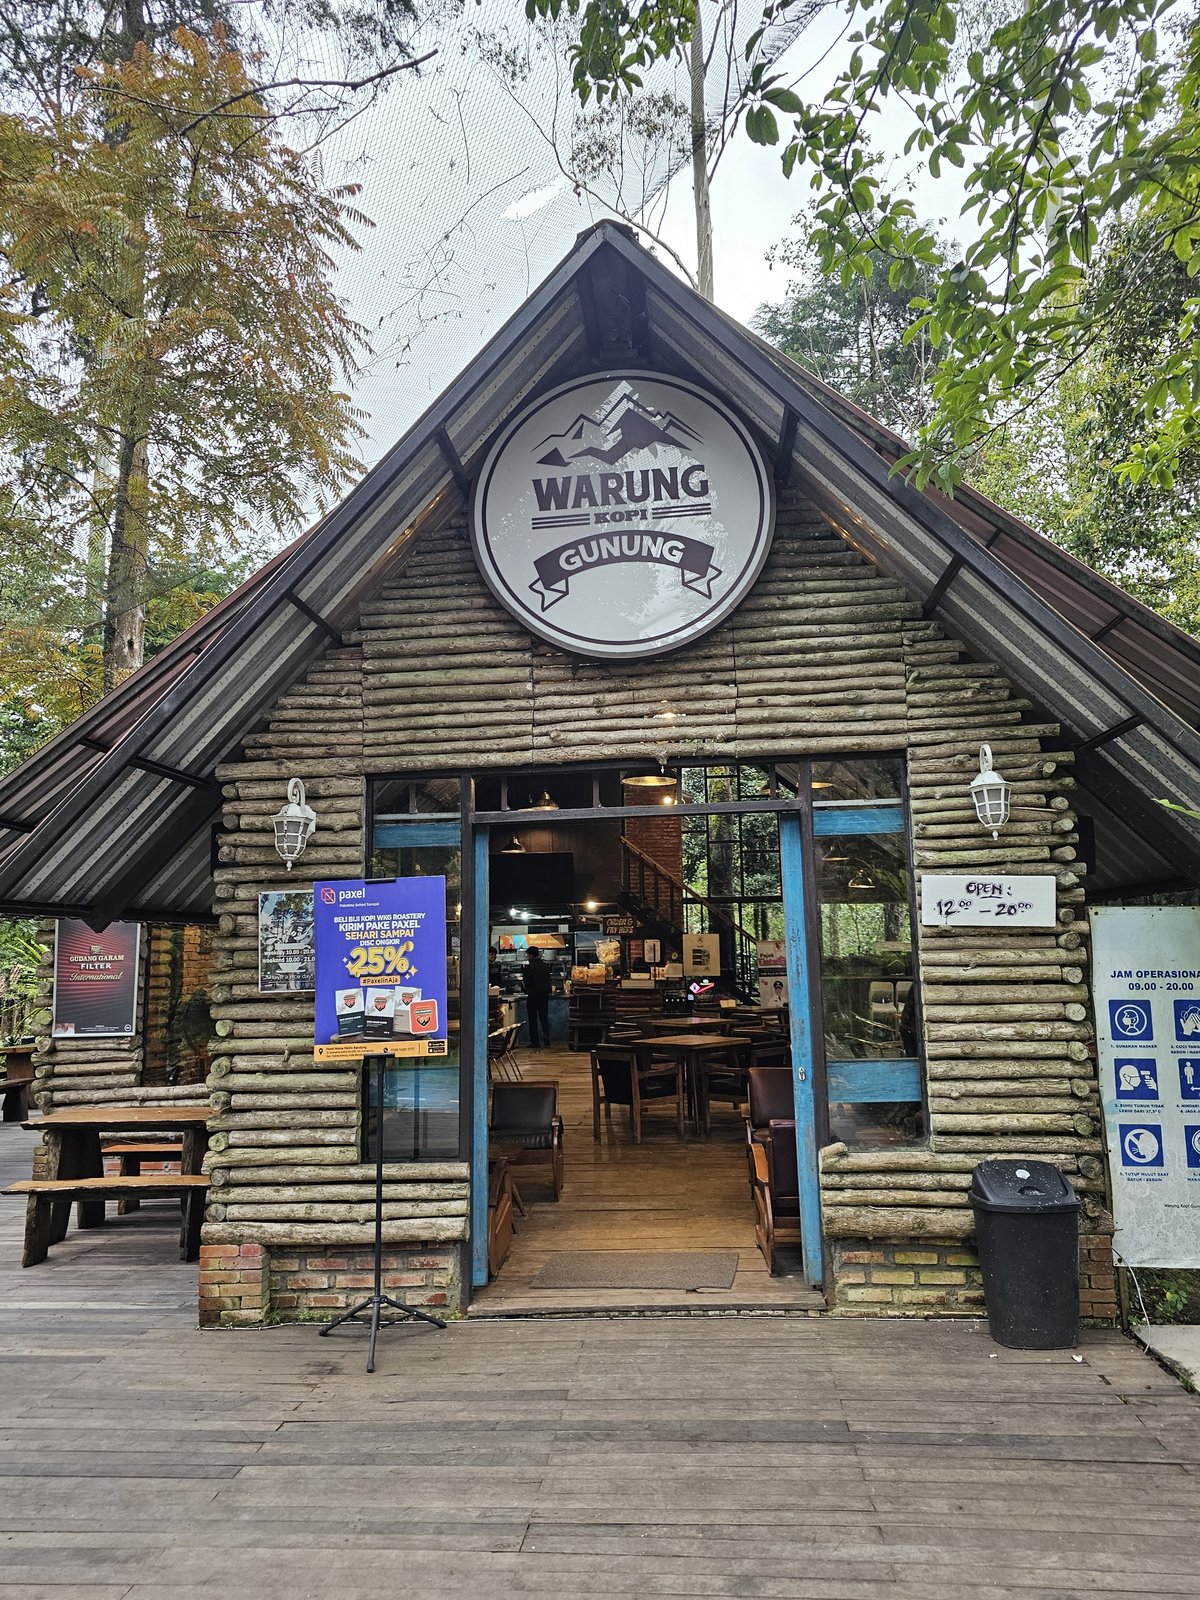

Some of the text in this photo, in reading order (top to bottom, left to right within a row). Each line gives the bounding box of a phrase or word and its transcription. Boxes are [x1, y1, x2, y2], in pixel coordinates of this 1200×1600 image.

[532, 464, 710, 512] WARUNG
[594, 510, 648, 524] KOPI
[558, 535, 686, 572] GUNUNG
[339, 888, 365, 902] paxel
[339, 920, 420, 932] KIRIM PAKE PAXEL
[345, 929, 414, 940] SEHARI SAMPAI
[350, 946, 409, 976] 25%
[69, 972, 124, 981] International
